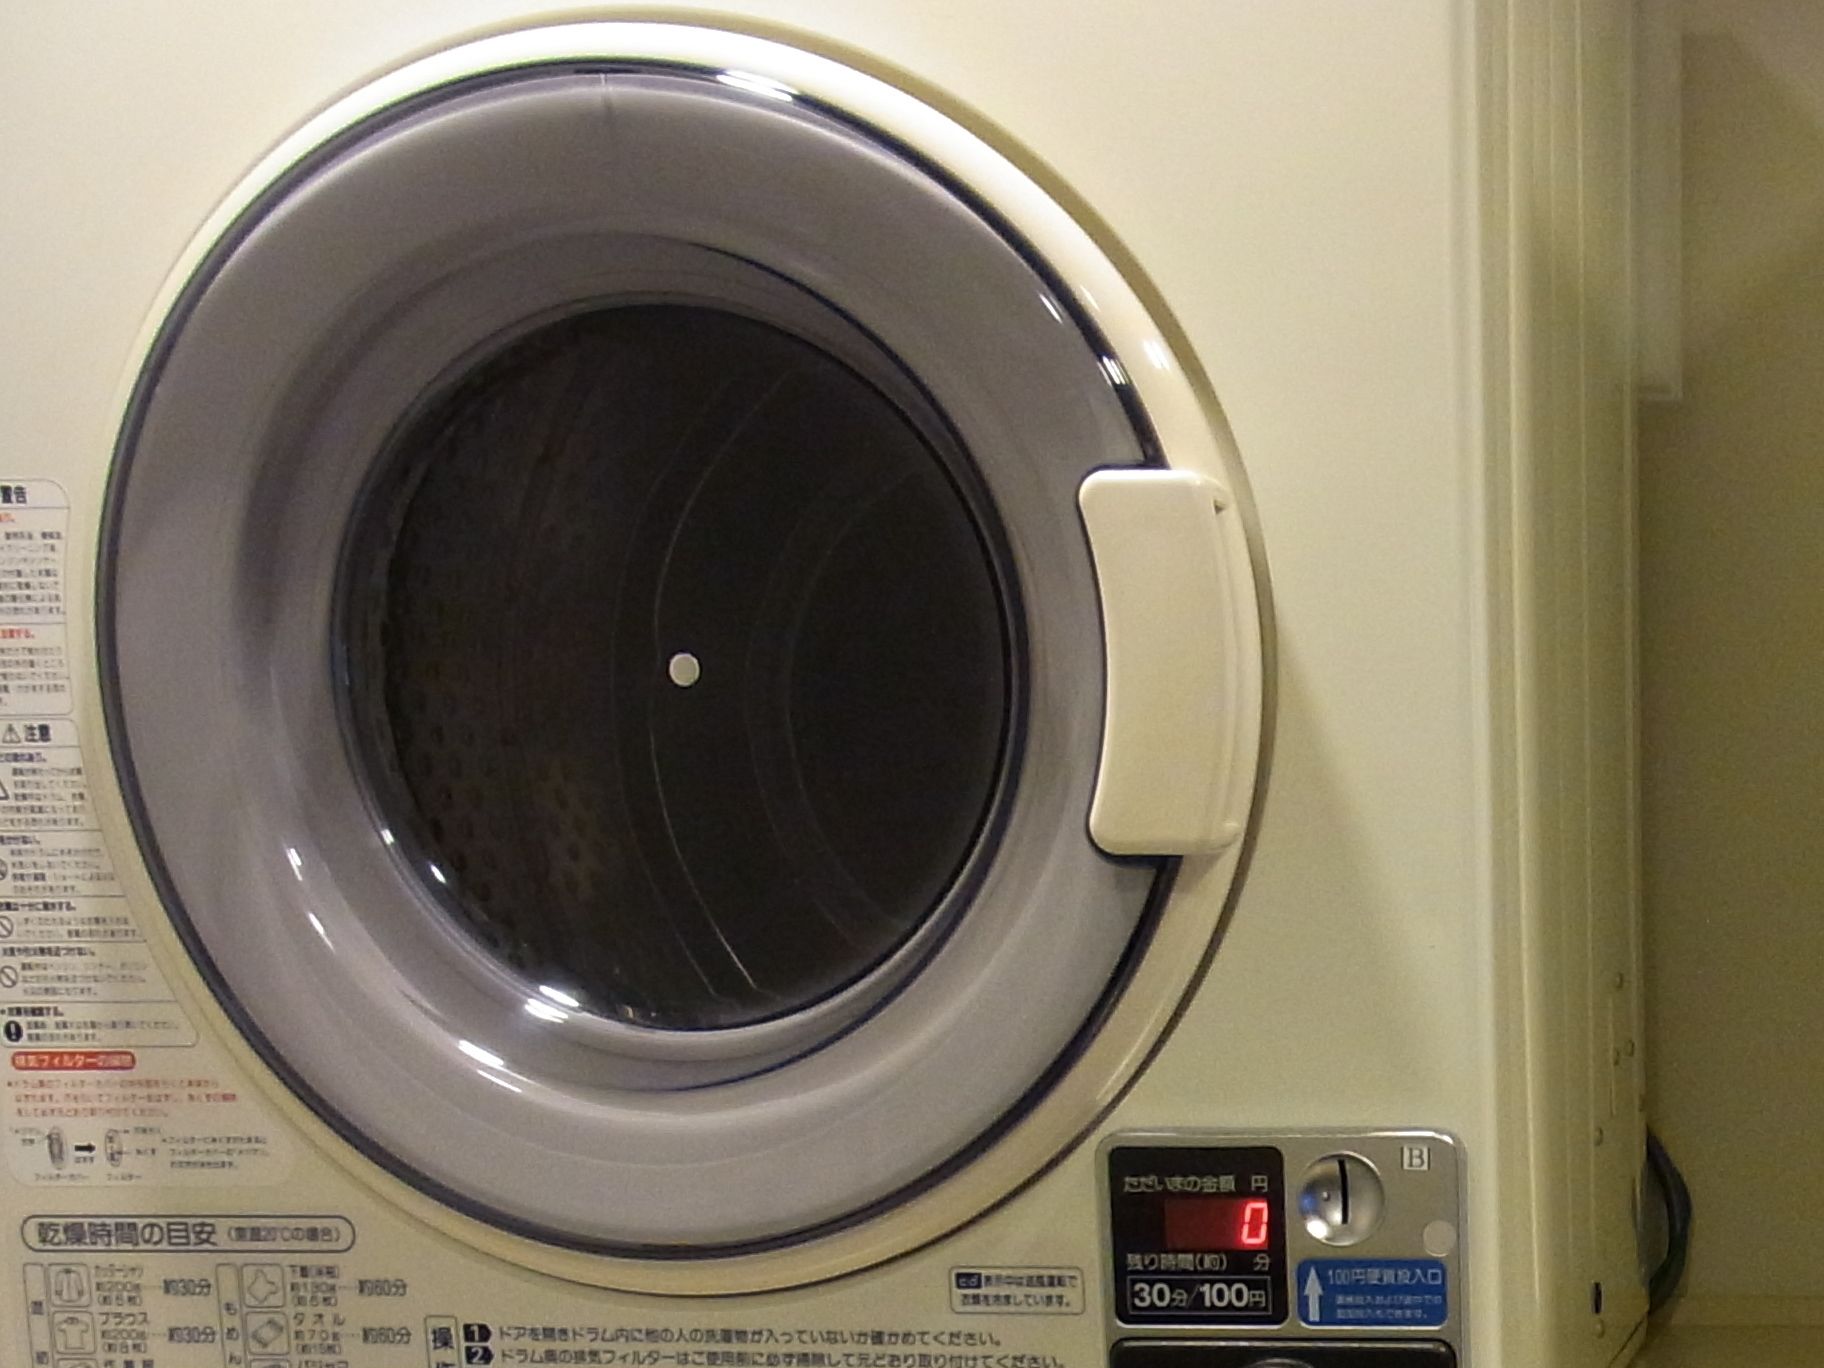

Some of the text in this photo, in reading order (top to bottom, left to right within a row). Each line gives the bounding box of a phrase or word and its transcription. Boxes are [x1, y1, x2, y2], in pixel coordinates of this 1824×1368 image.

[1407, 1147, 1424, 1168] B
[1251, 1176, 1269, 1192] 円
[37, 1223, 217, 1246] 乾燥時間の目安
[1241, 1202, 1269, 1245] 0
